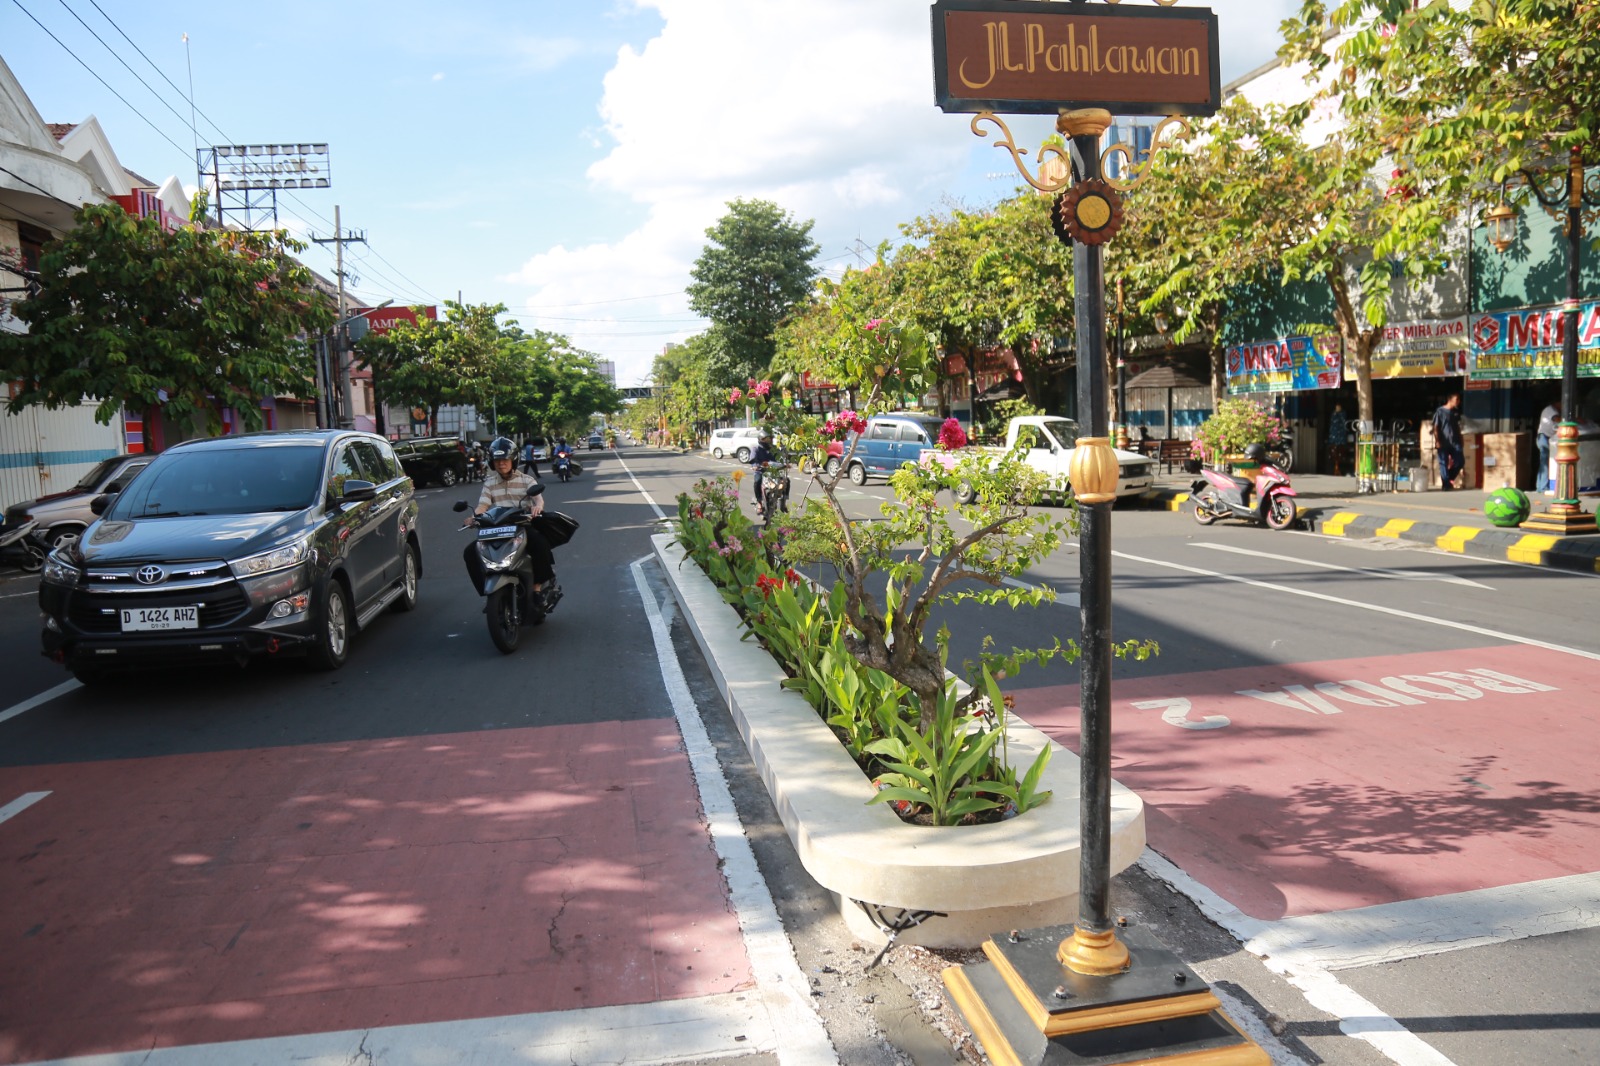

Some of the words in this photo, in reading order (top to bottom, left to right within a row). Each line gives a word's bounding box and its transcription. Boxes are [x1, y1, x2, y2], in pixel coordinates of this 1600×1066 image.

[1404, 323, 1432, 339] MIRA
[1435, 321, 1464, 336] JAYA
[1243, 343, 1292, 370] MIRA
[123, 611, 131, 624] D
[140, 609, 169, 623] 1424
[174, 608, 195, 621] AHZ
[1234, 668, 1562, 715] RODA
[1129, 697, 1230, 730] 2
